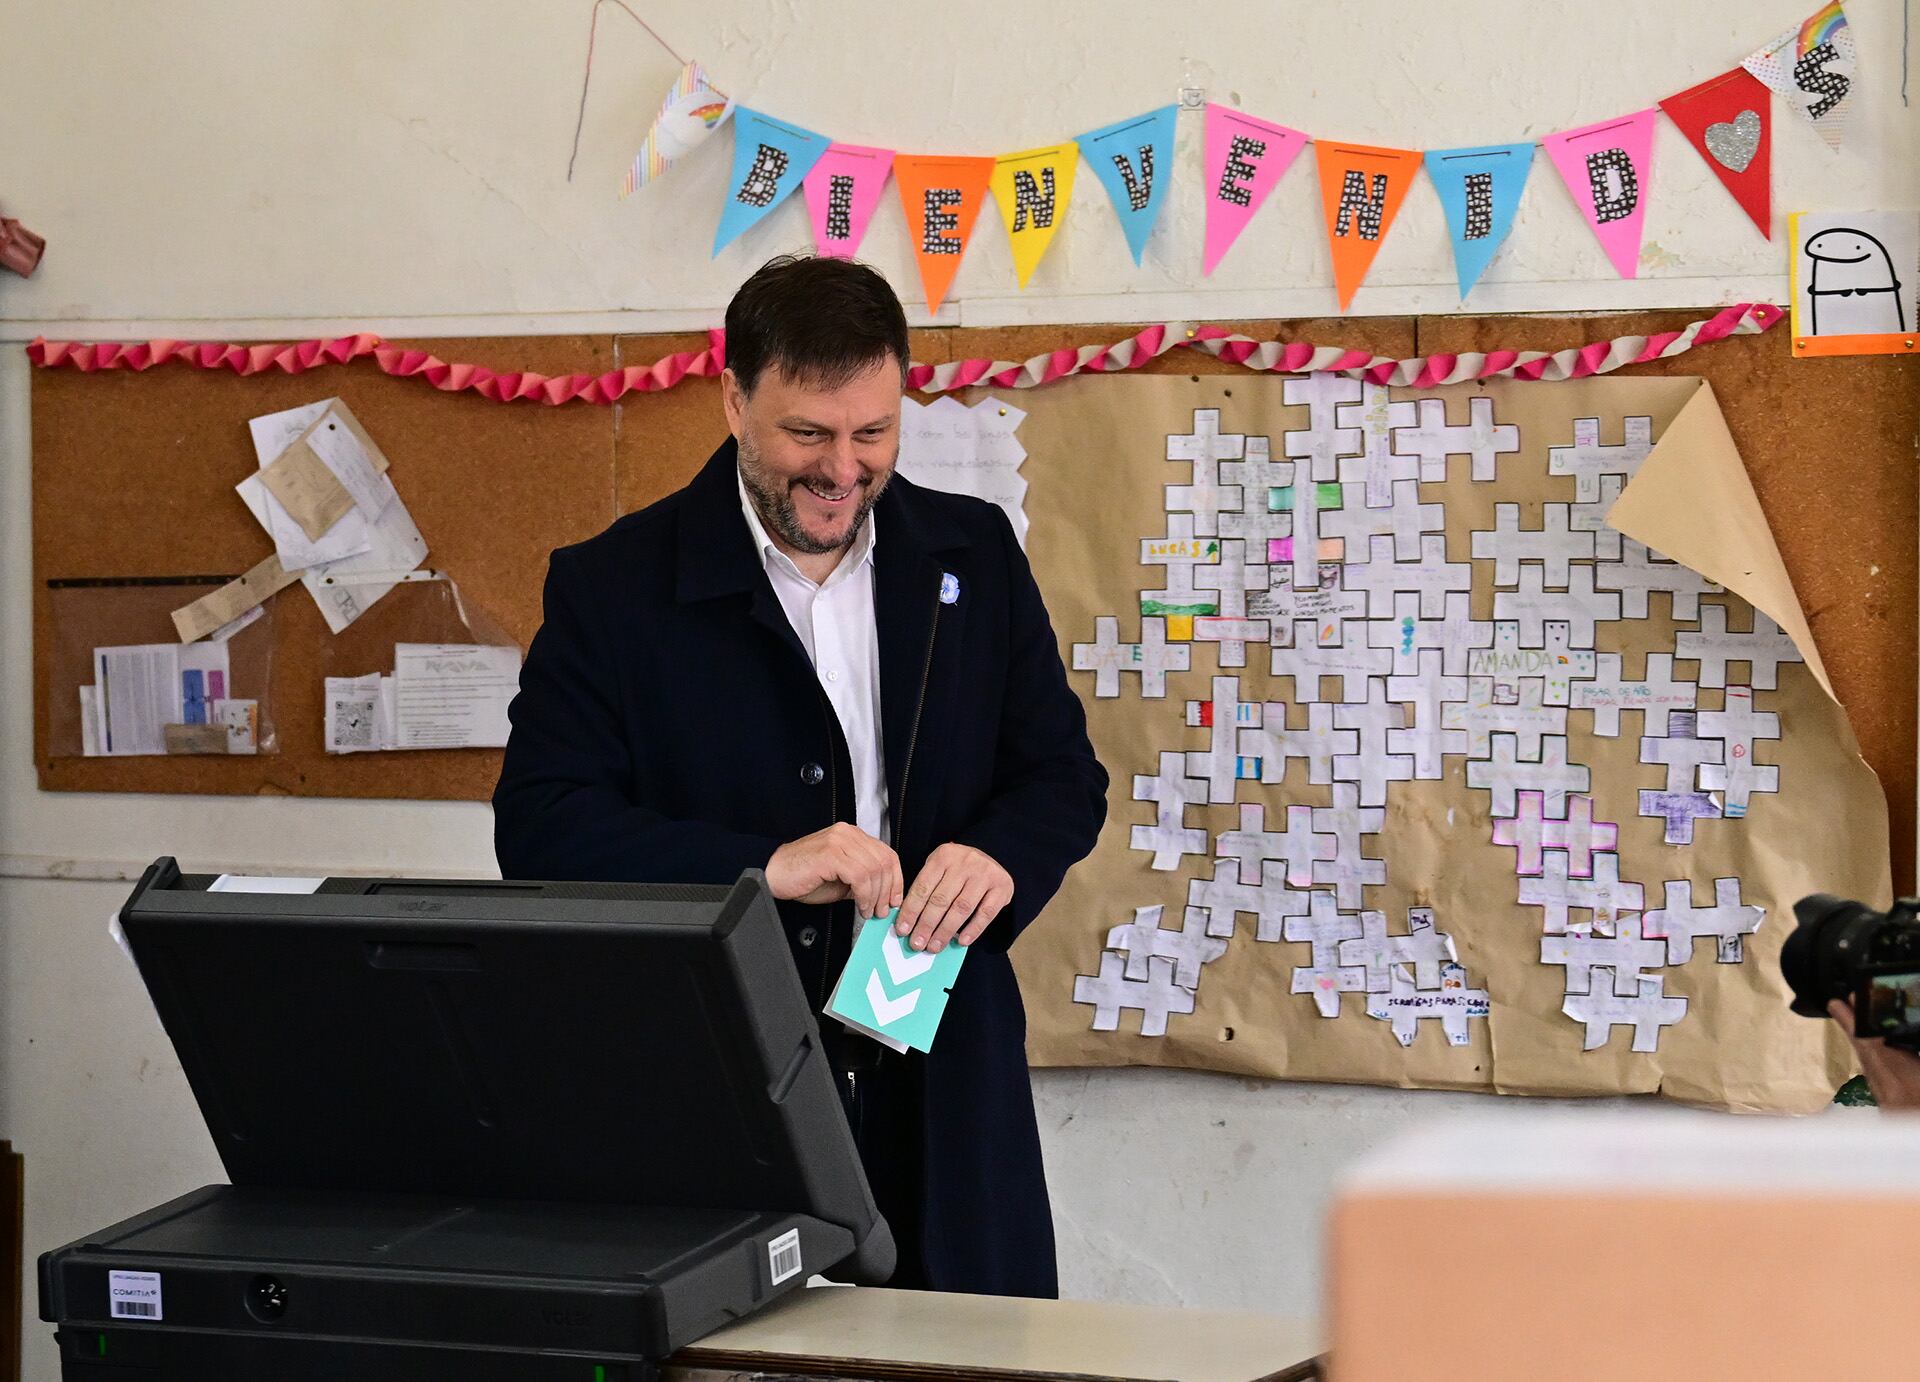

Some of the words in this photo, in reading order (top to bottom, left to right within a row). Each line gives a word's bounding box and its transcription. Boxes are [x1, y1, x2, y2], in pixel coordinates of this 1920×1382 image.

[1149, 541, 1201, 563] LUCAS
[1473, 648, 1554, 673] AMANDA
[112, 1288, 151, 1297] COMITIA
